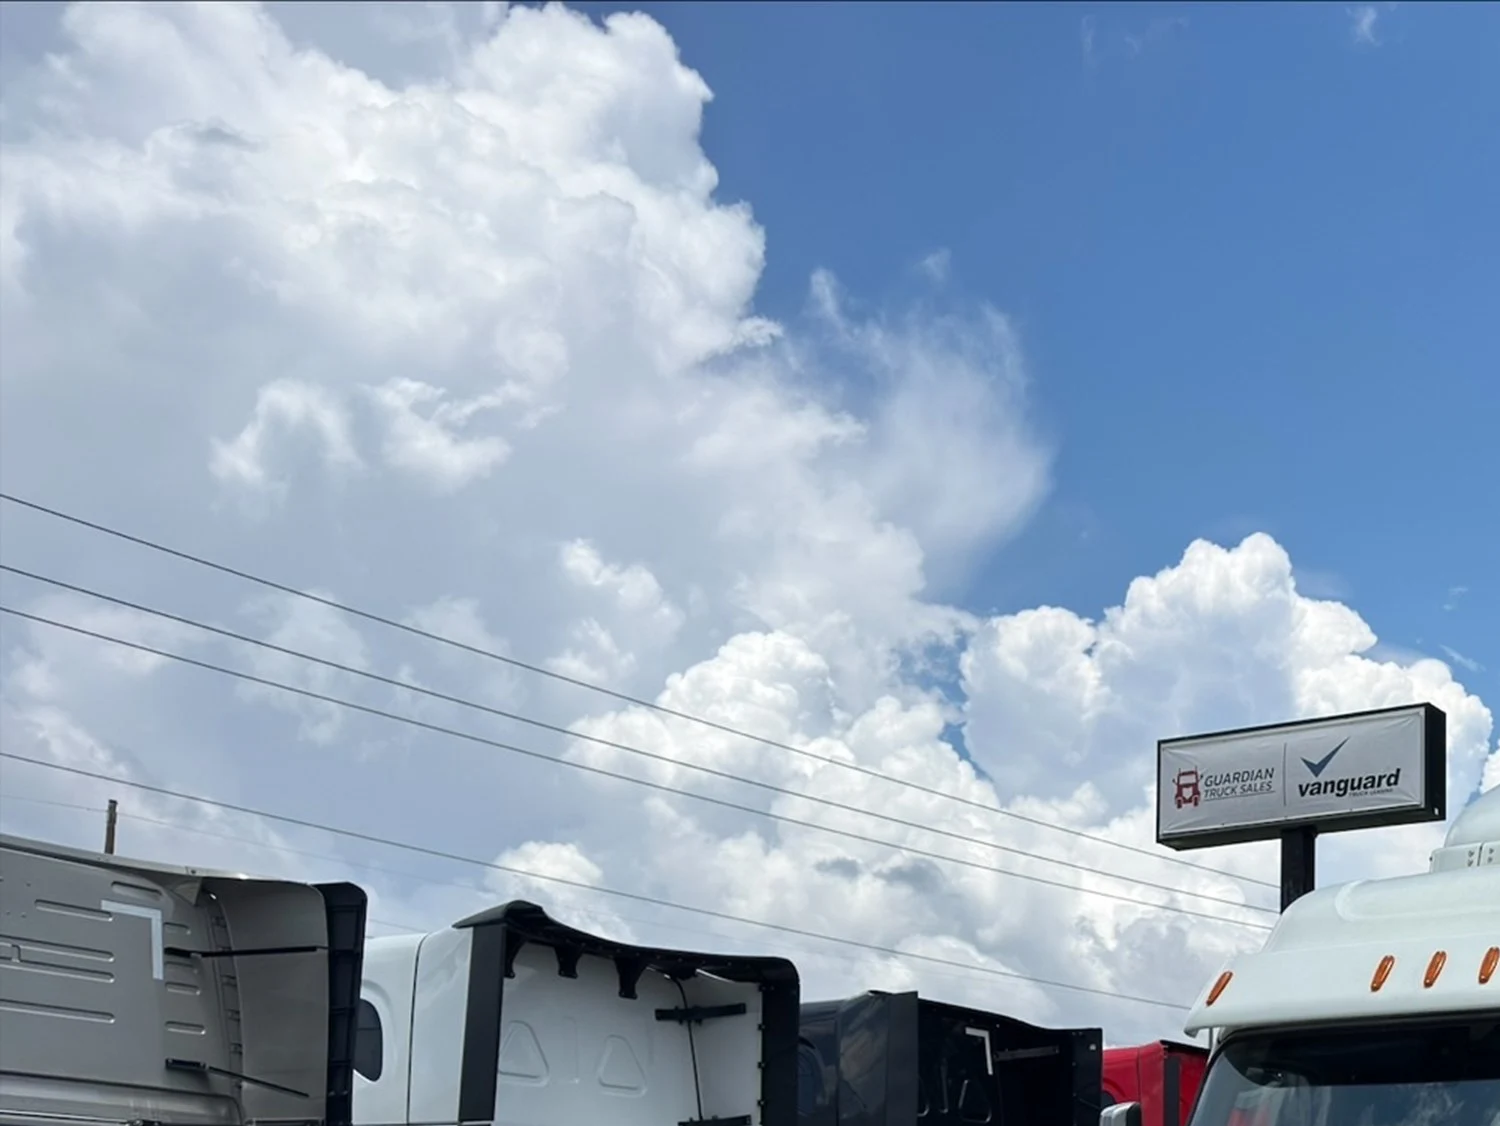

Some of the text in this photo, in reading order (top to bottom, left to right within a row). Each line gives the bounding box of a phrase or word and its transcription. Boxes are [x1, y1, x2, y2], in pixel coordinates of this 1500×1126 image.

[1204, 767, 1275, 788] GUARDIAN
[1298, 767, 1401, 798] vanguard
[1204, 780, 1273, 798] TRUCK SALES
